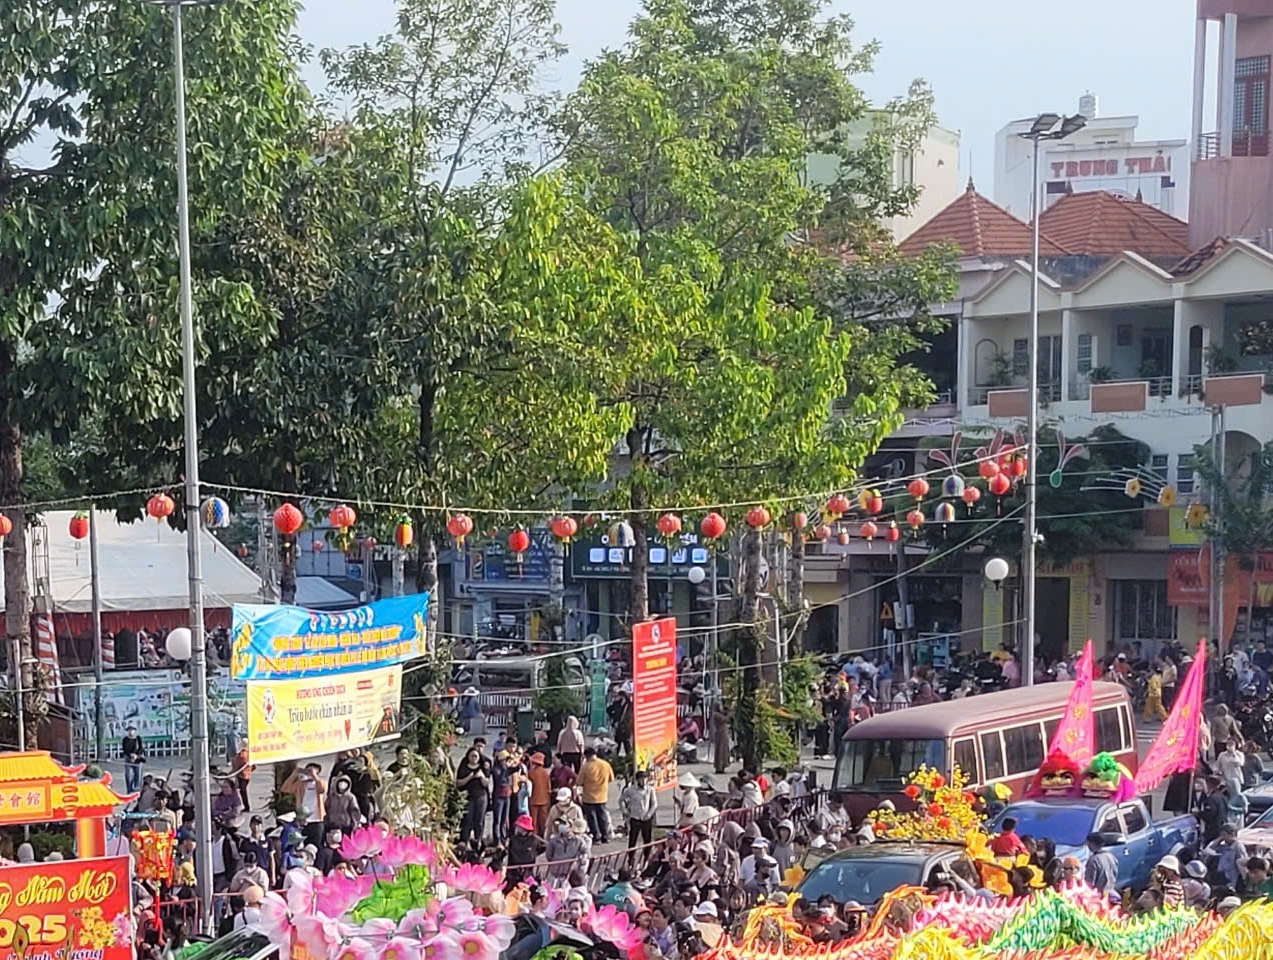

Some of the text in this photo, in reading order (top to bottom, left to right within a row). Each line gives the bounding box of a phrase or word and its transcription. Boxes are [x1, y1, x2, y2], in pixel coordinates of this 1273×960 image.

[1050, 159, 1118, 178] TRUNG
[15, 874, 65, 906] Năm
[67, 869, 117, 903] Mới
